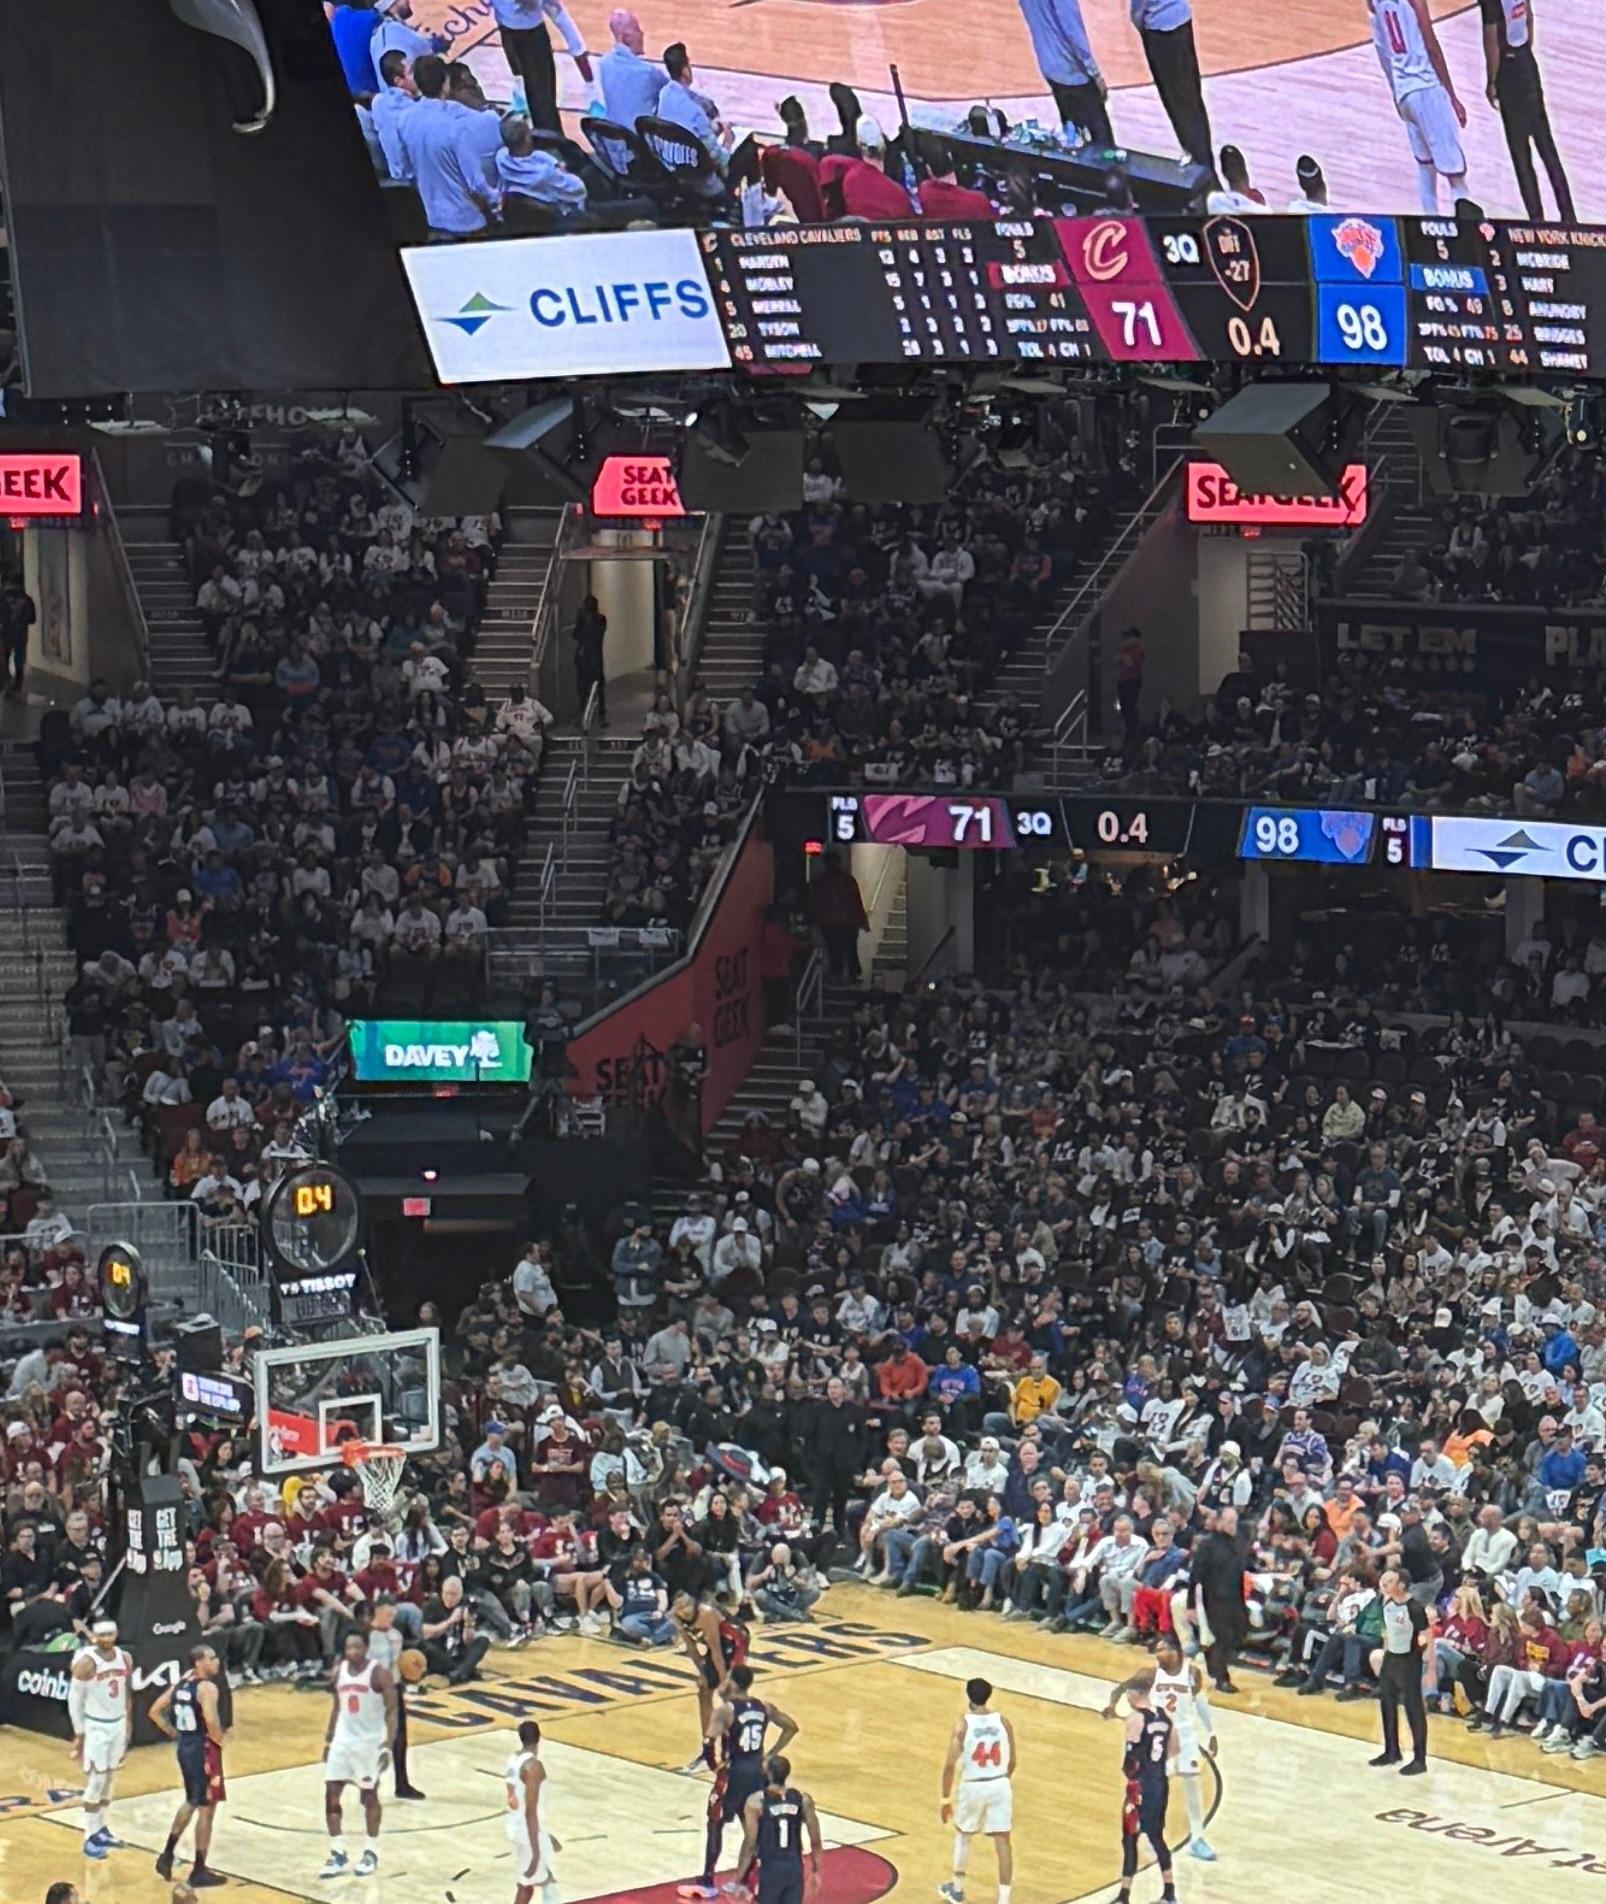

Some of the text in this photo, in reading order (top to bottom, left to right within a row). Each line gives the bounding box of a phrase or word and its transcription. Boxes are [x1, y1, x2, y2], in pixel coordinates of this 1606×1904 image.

[801, 228, 861, 244] CAVALIERS
[1163, 235, 1200, 264] 3Q
[1437, 241, 1448, 260] 5
[1226, 260, 1250, 282] -27
[1424, 269, 1474, 288] BONUS
[529, 279, 711, 328] CLIFFS
[1112, 301, 1161, 346] 71
[1336, 304, 1387, 350] 98
[1228, 317, 1280, 357] 0.4
[622, 465, 673, 486] SEAT
[620, 487, 678, 508] GEEK
[836, 815, 855, 841] 5
[949, 805, 992, 842] 71
[1016, 812, 1052, 837] 3Q
[1098, 810, 1148, 845] 0.4
[1254, 816, 1299, 855] 98
[1387, 838, 1404, 865] 5
[385, 1044, 472, 1068] DAVEY
[296, 1184, 332, 1215] 0.4
[301, 1272, 357, 1293] TISSOT
[155, 1507, 178, 1526] GET
[157, 1526, 178, 1547] THE
[17, 1669, 71, 1701] coinb
[107, 1677, 120, 1698] 3
[347, 1695, 360, 1714] 0
[1165, 1693, 1177, 1714] 2
[740, 1724, 764, 1753] 45
[971, 1741, 1001, 1769] 44
[778, 1818, 789, 1849] 1
[1374, 1807, 1571, 1858] Arena
